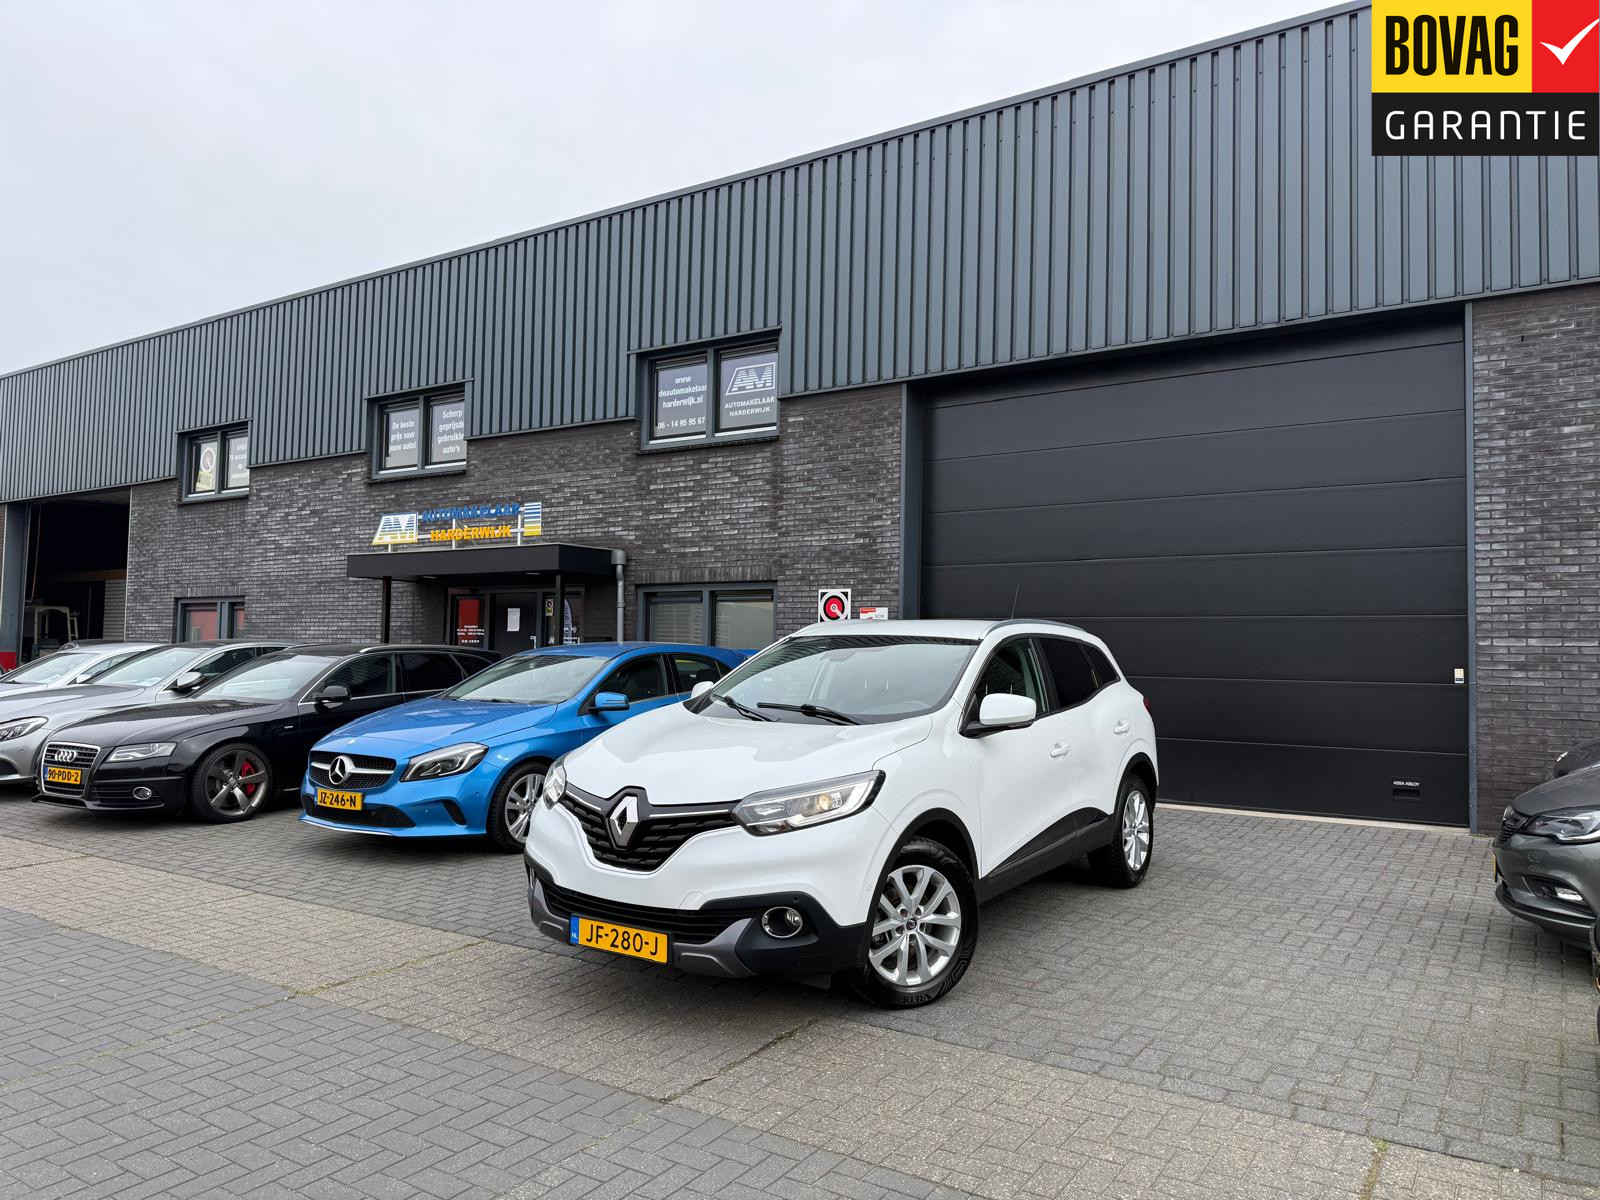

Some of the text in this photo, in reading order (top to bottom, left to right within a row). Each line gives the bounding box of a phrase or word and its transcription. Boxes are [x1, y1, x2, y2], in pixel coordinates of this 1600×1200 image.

[674, 375, 692, 384] www
[658, 384, 707, 398] deautomakelaar
[662, 394, 704, 408] harderwijk.nl
[724, 396, 775, 409] AUTOMAKELAAR
[442, 409, 463, 419] Scherp
[729, 406, 771, 417] HARDERWIJK
[400, 420, 415, 429] beste
[657, 421, 666, 430] 06
[671, 420, 679, 428] 14
[679, 418, 687, 427] 95
[688, 417, 697, 426] 95
[697, 416, 706, 425] 67
[421, 502, 520, 522] AUTOMAKELAAR
[429, 525, 512, 542] HARDERWIJK
[47, 768, 79, 782] 90-PDD-2
[319, 791, 357, 808] JZ-246-N
[586, 924, 658, 955] JF-280-J
